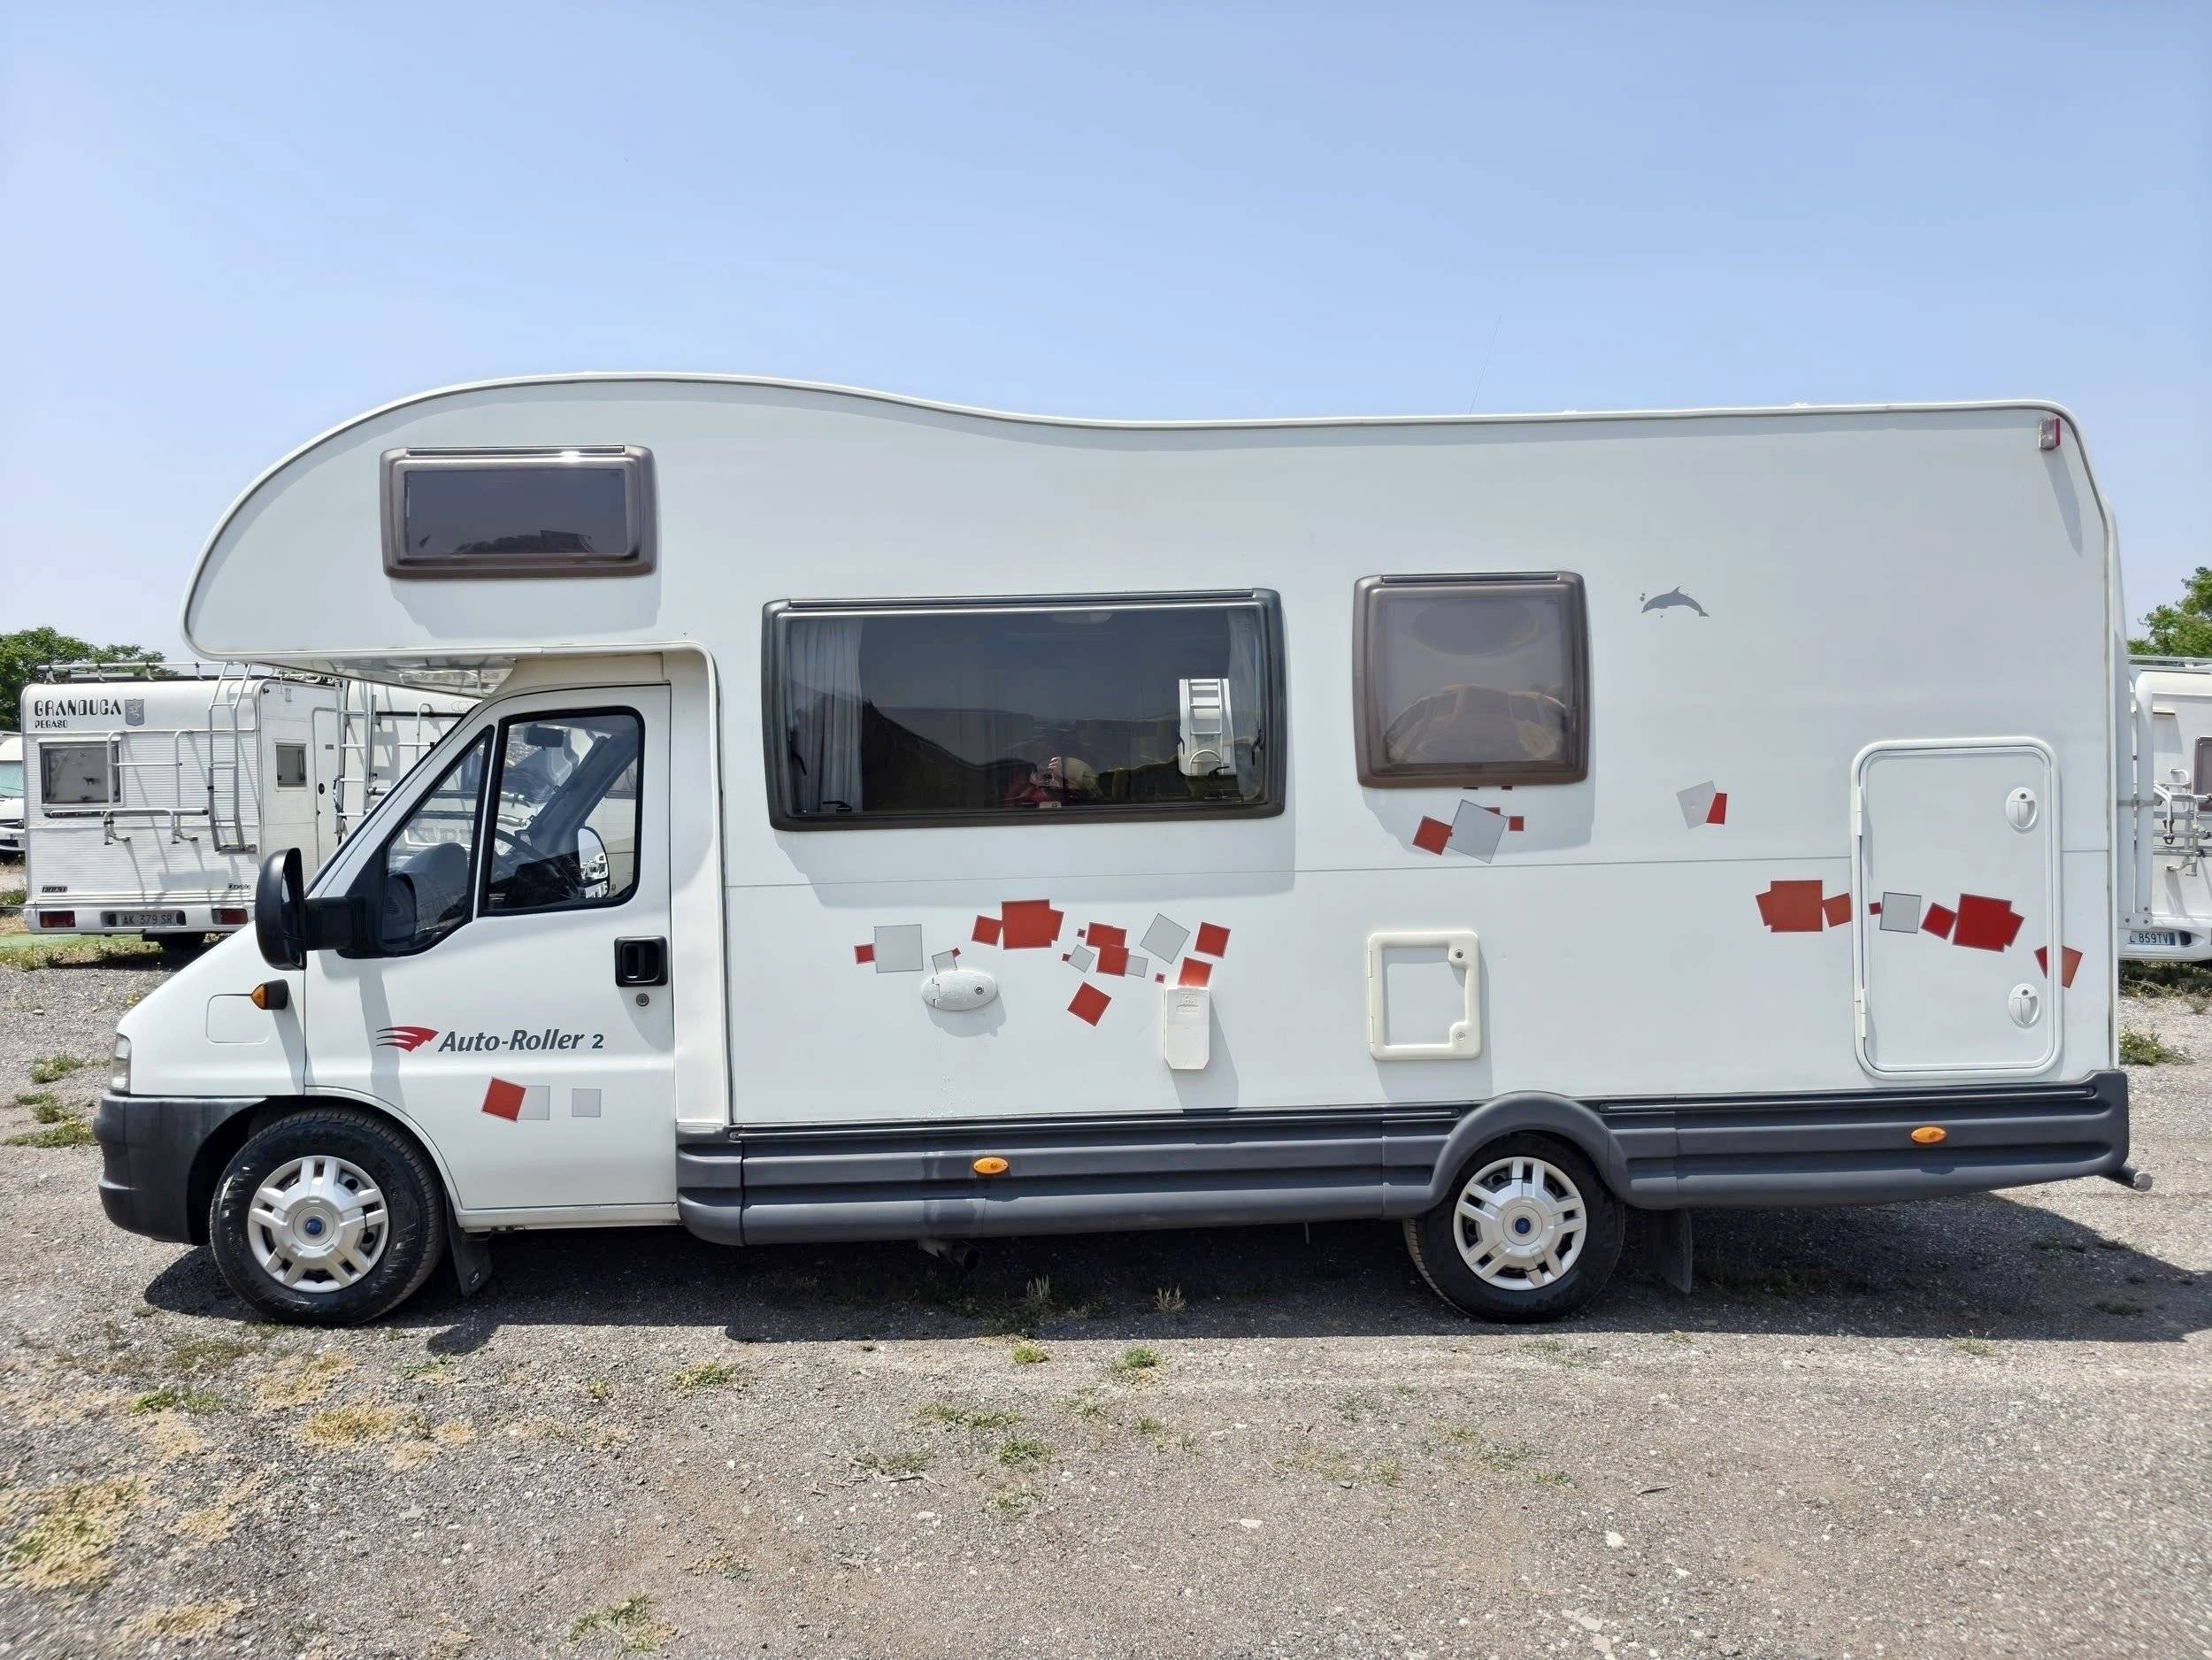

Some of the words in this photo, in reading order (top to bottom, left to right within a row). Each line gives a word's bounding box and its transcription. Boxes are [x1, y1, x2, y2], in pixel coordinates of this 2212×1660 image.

[35, 698, 122, 717] GRANDUCA
[35, 719, 68, 728] PEGASO
[140, 914, 157, 925] 379
[2139, 933, 2168, 944] 859TV
[438, 1028, 585, 1053] Auto-Roller
[591, 1033, 604, 1049] 2
